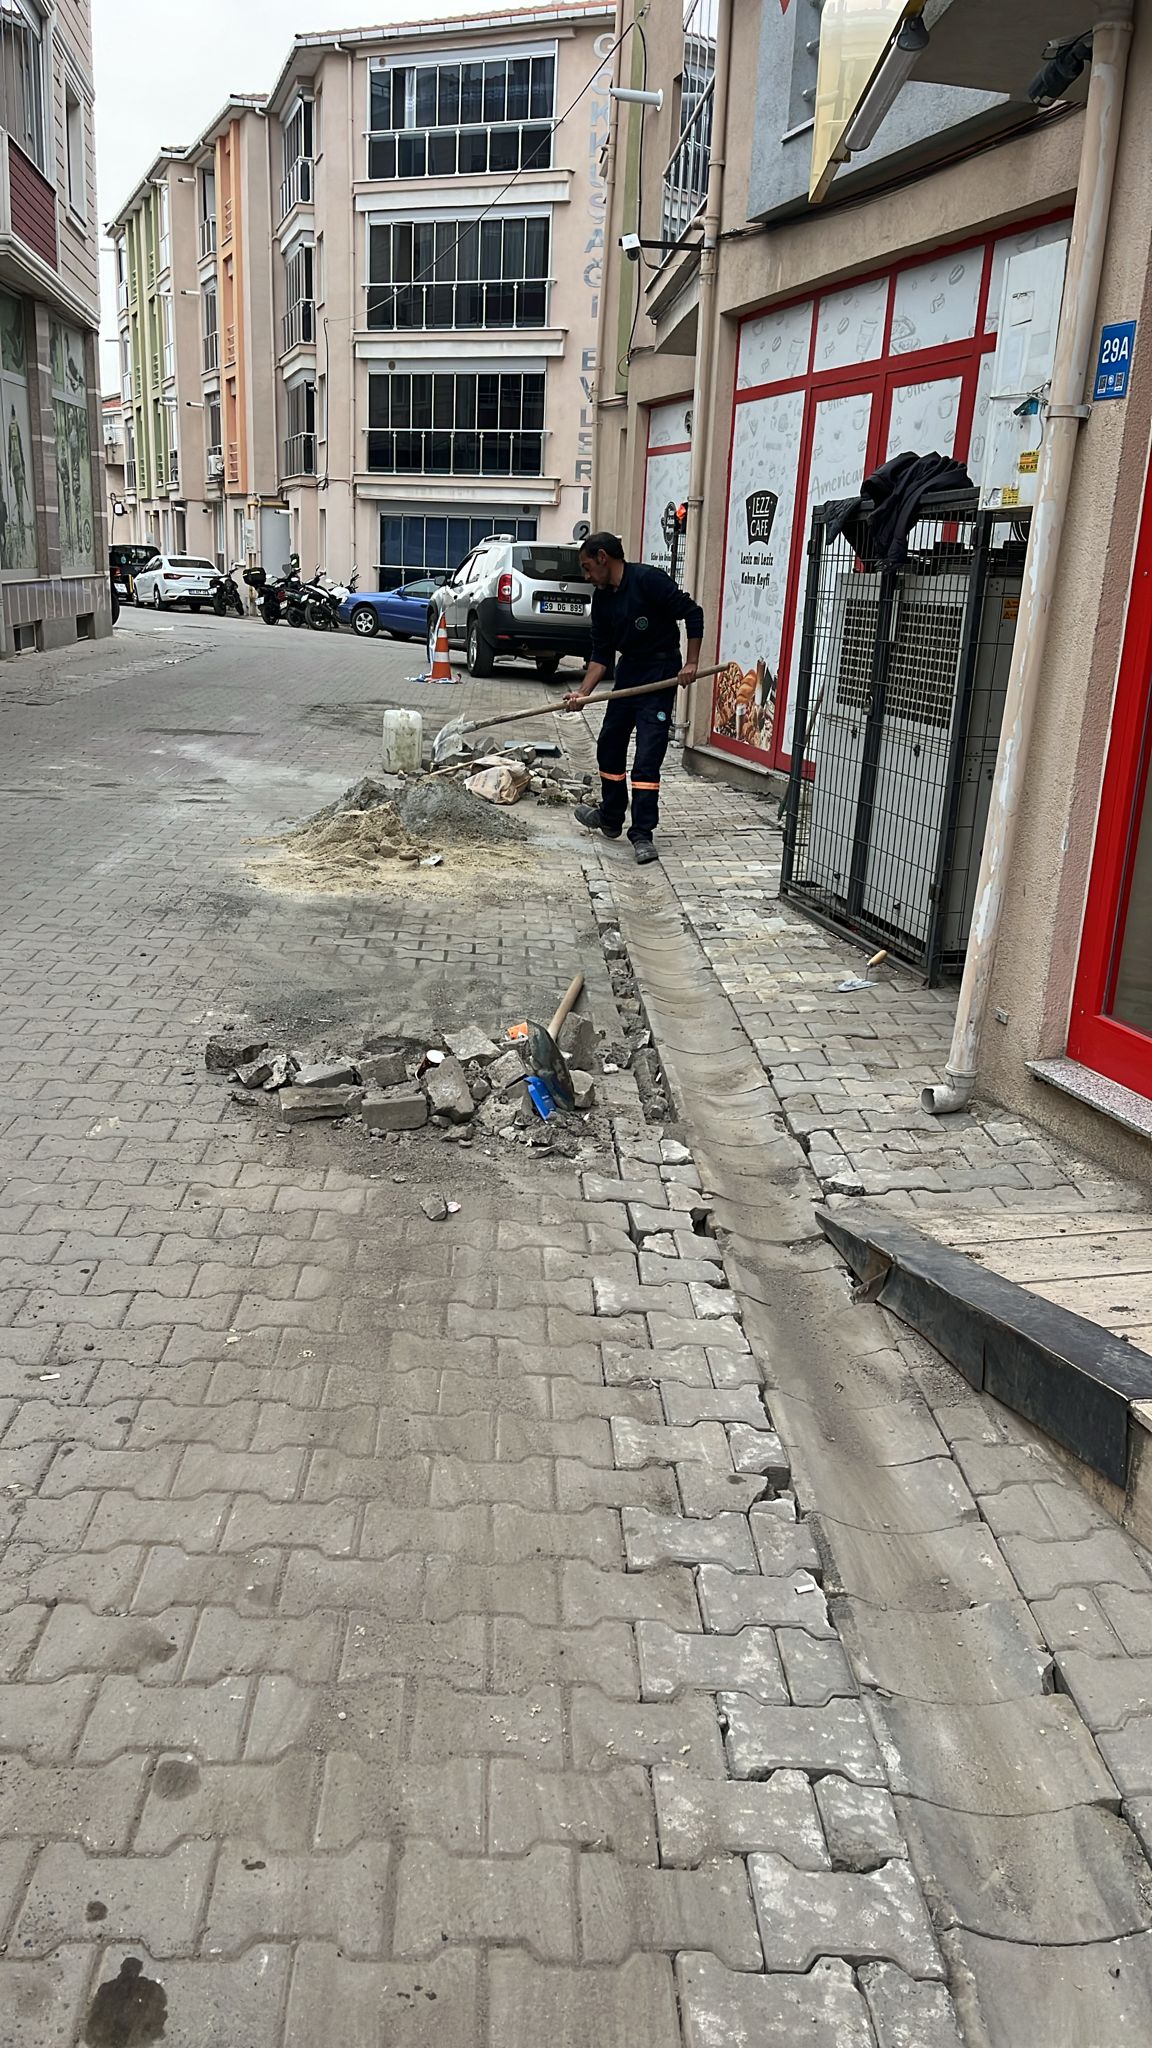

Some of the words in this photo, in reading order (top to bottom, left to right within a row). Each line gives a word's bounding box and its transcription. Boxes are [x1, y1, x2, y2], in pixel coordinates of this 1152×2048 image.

[1101, 336, 1129, 364] 29A
[752, 497, 770, 517] LEZZ
[750, 519, 769, 537] CAFE
[741, 572, 755, 585] Kahve
[756, 572, 770, 590] Keyfi
[544, 602, 553, 611] 59
[557, 603, 566, 611] DG
[570, 604, 583, 613] 895
